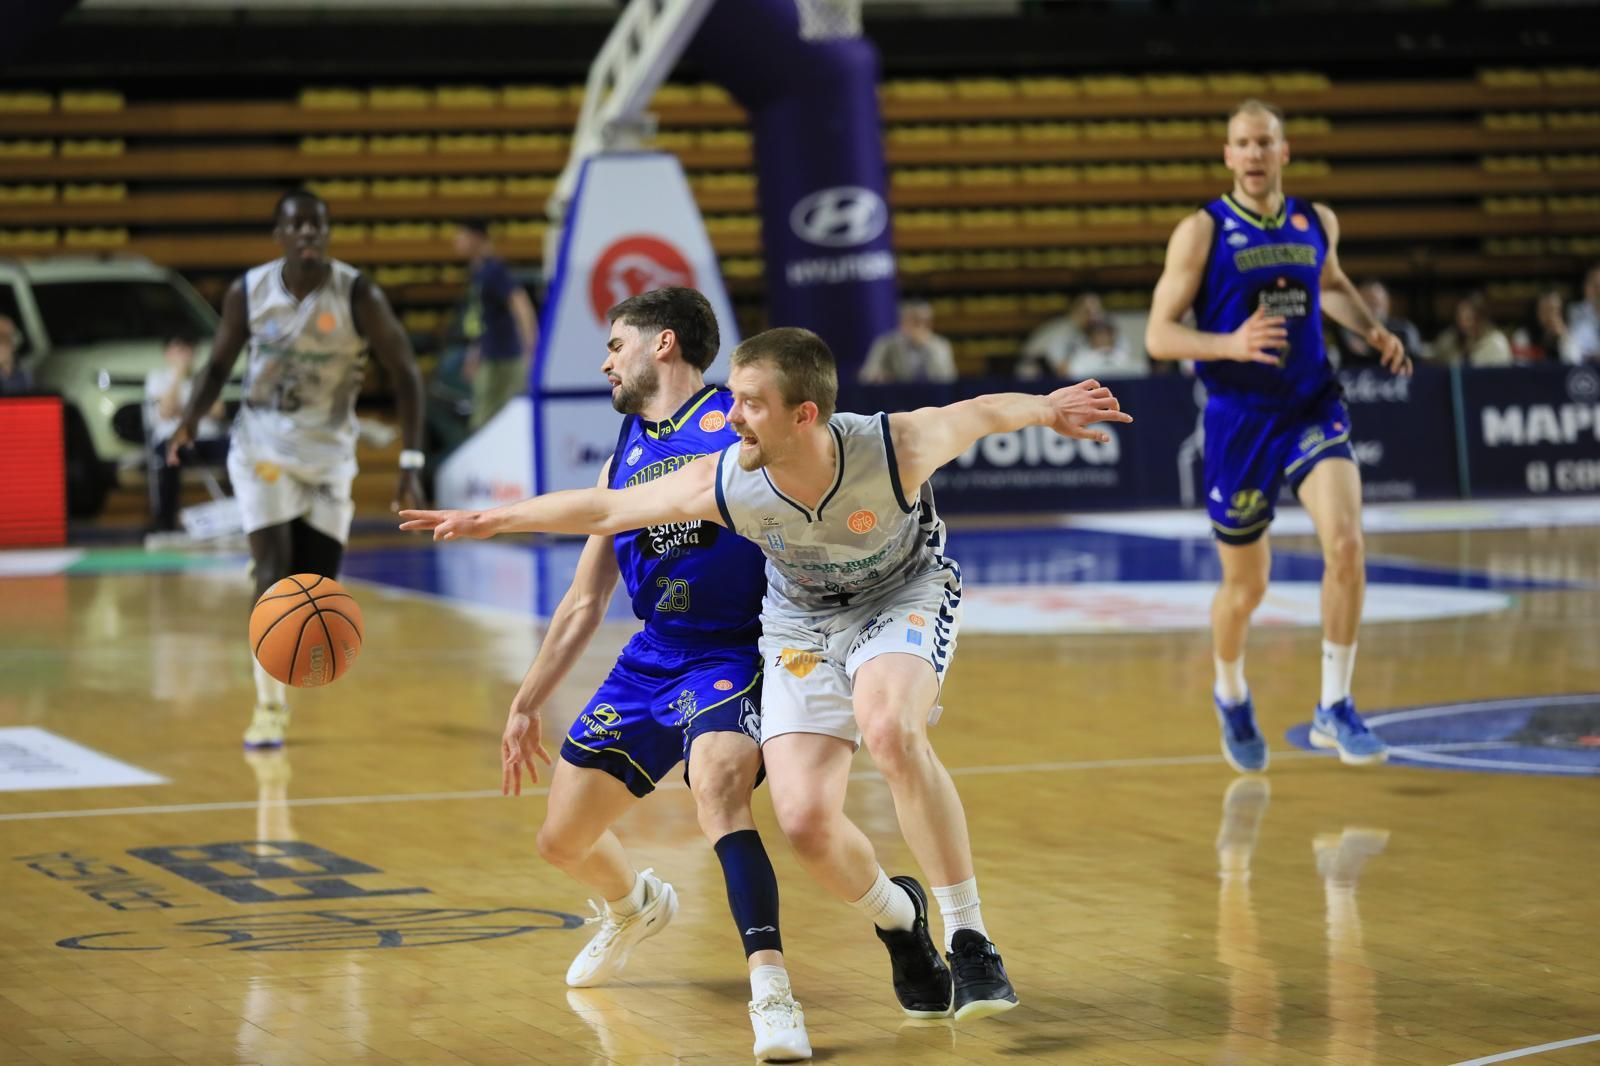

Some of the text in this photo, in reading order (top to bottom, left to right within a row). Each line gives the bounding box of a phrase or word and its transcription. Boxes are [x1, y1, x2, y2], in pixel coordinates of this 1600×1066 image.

[1481, 404, 1600, 447] MAP
[624, 453, 708, 488] OUREN
[656, 577, 690, 612] 28
[580, 714, 622, 741] HYUNDAI
